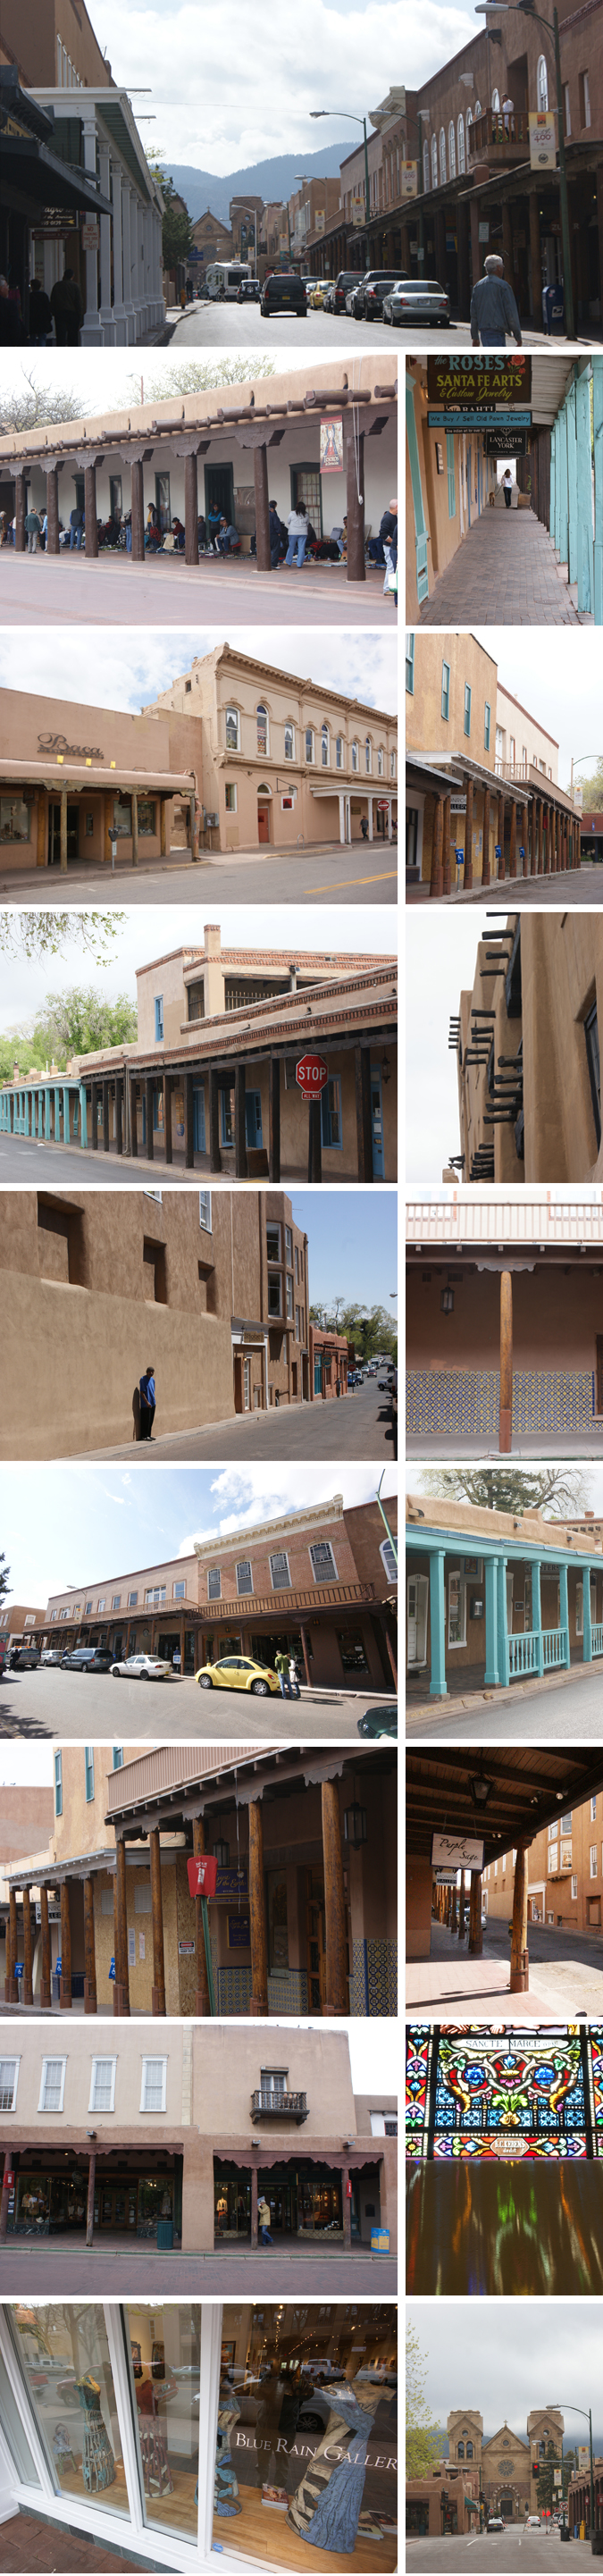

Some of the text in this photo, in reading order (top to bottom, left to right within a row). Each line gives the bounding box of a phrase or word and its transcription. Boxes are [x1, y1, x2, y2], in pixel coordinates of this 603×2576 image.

[534, 134, 551, 143] 400
[42, 206, 63, 215] agro
[434, 356, 448, 365] the
[436, 374, 523, 387] SANTA FE ARTS
[440, 387, 513, 402] & Custom Jewelry
[38, 732, 104, 754] Baca
[297, 1066, 327, 1081] STOP
[440, 1838, 467, 1857] Purple
[459, 1850, 479, 1867] Sage
[216, 1872, 230, 1882] pirit
[465, 2040, 503, 2048] SANCTE
[236, 2432, 272, 2451] BLUE
[275, 2437, 318, 2458] RAIN
